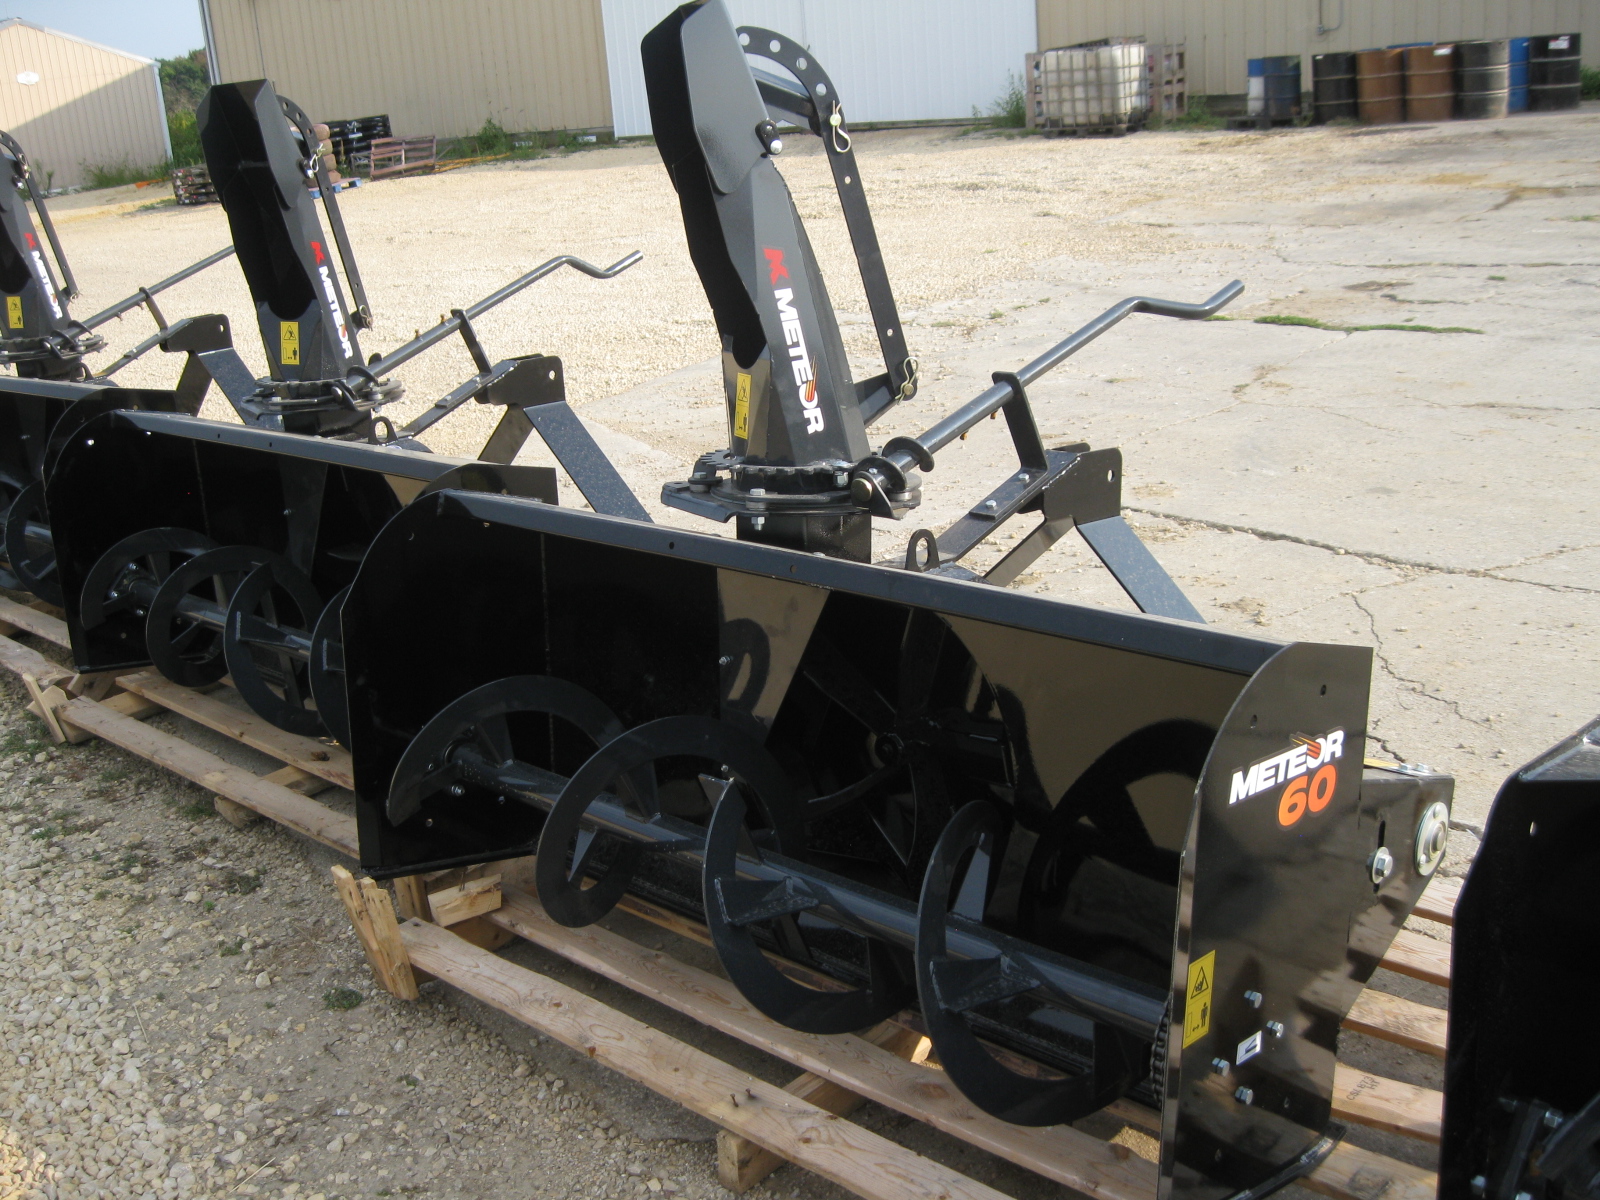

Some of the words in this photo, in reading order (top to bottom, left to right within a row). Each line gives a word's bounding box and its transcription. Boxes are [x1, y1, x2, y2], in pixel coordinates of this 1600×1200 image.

[318, 265, 354, 359] METEOR
[773, 287, 825, 434] METEOR
[1229, 730, 1345, 805] METEOR
[1278, 764, 1337, 827] 60
